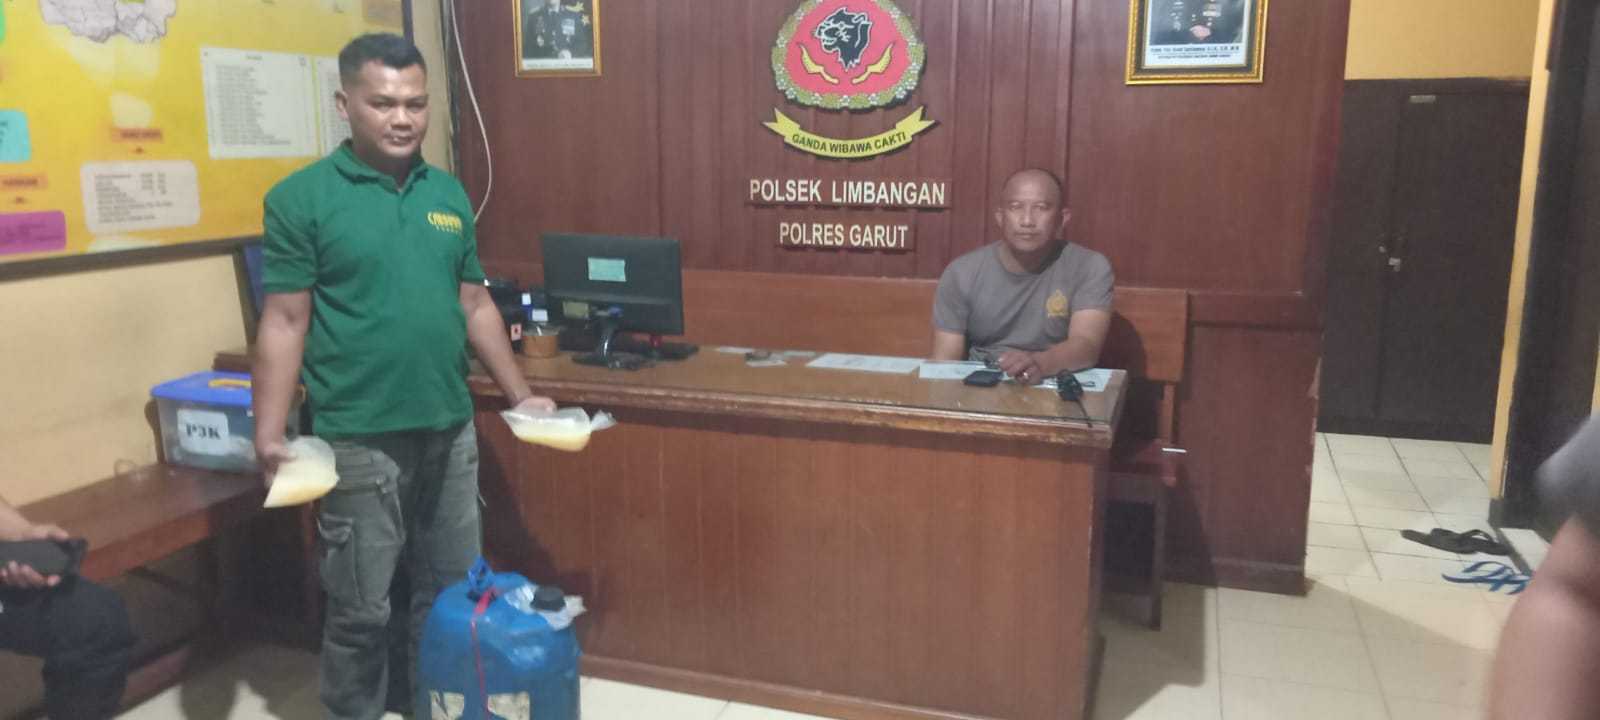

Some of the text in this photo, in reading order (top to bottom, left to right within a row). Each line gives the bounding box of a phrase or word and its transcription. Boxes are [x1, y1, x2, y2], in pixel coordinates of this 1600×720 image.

[792, 132, 907, 153] GANDA WIBAWA CAKTI
[750, 179, 945, 205] POLSEK LIMBANGAN
[779, 222, 908, 248] POLRES GARUT
